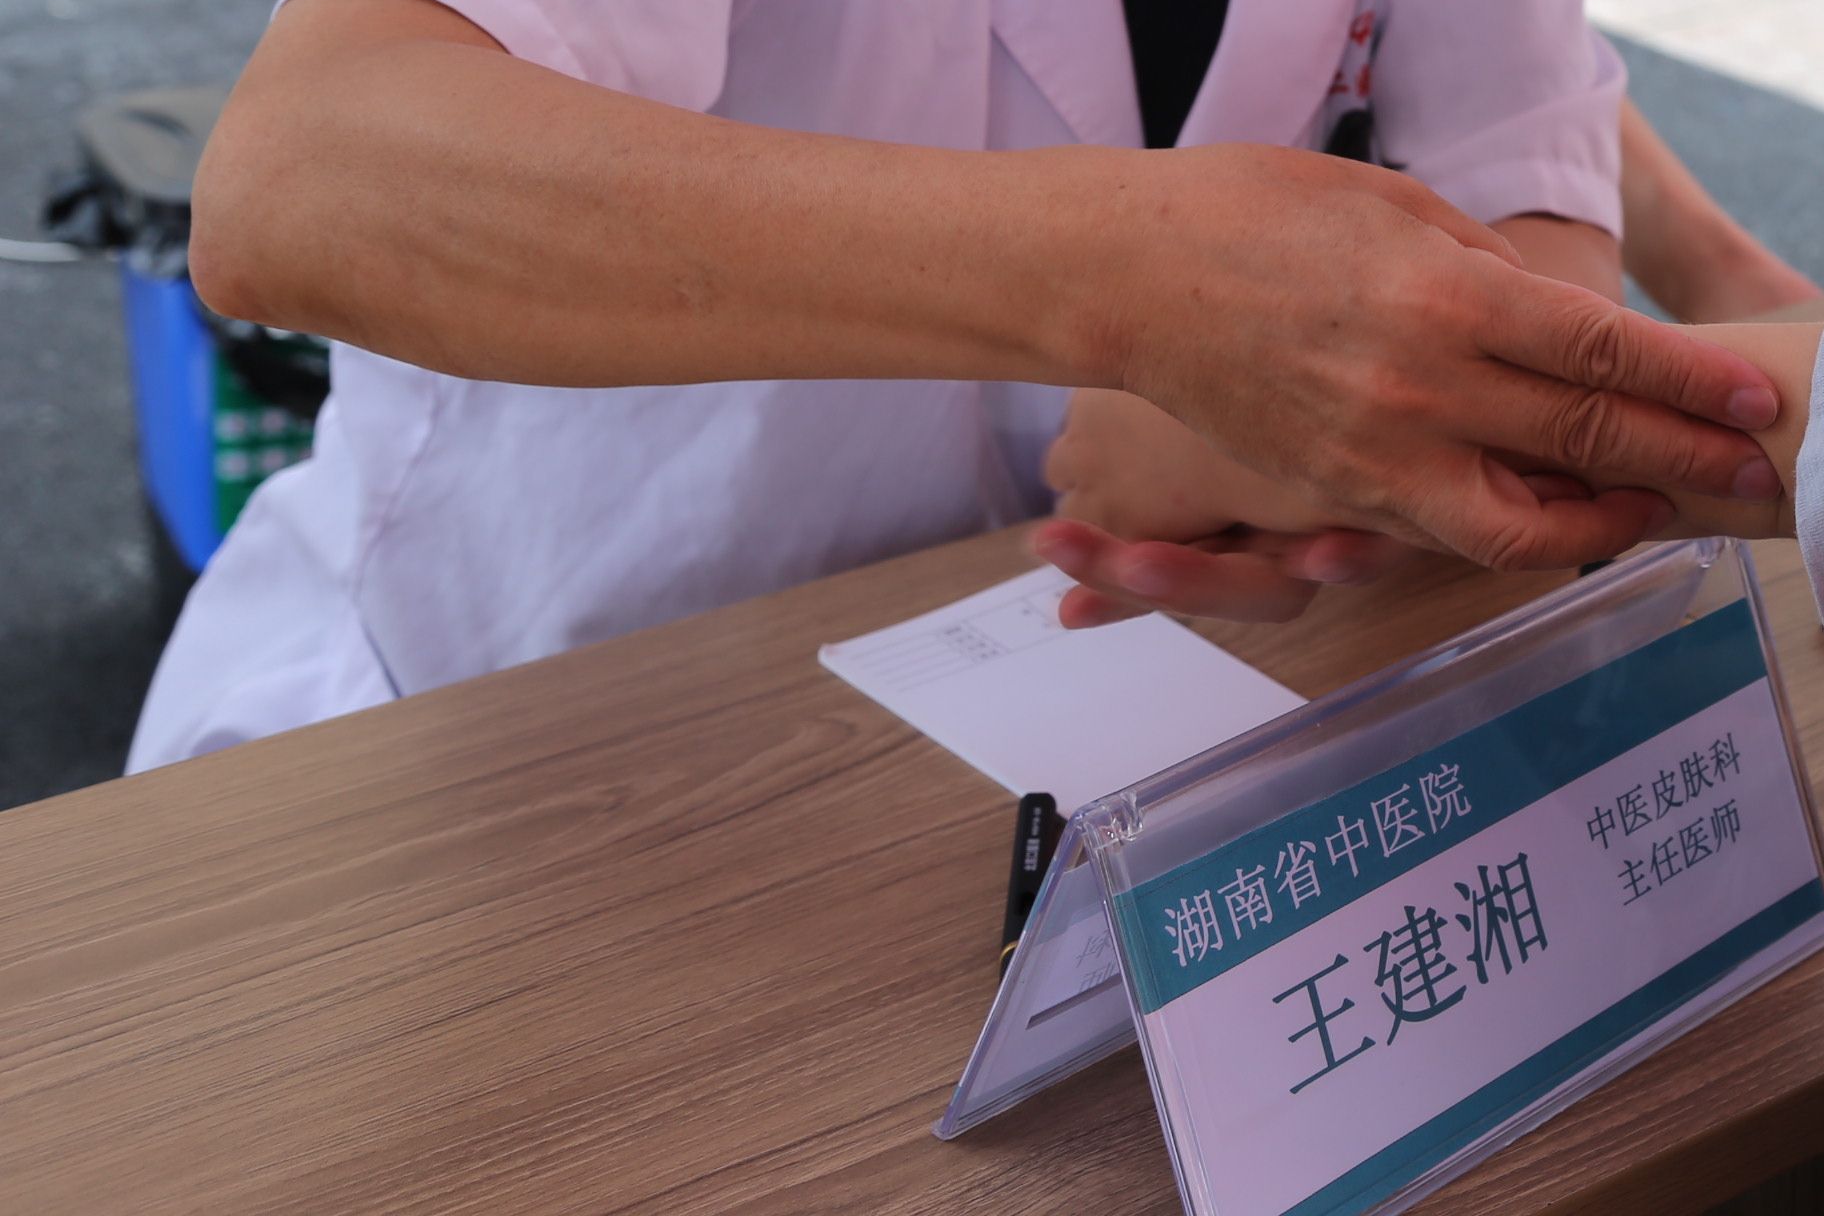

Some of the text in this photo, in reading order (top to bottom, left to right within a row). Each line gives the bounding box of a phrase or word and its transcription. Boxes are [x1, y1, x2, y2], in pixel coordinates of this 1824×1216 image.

[1164, 763, 1473, 968] 湖南省中医院
[1586, 731, 1741, 851] 中医皮肤科
[1617, 798, 1741, 906] 主任医师
[1271, 851, 1549, 1096] 王建湘
